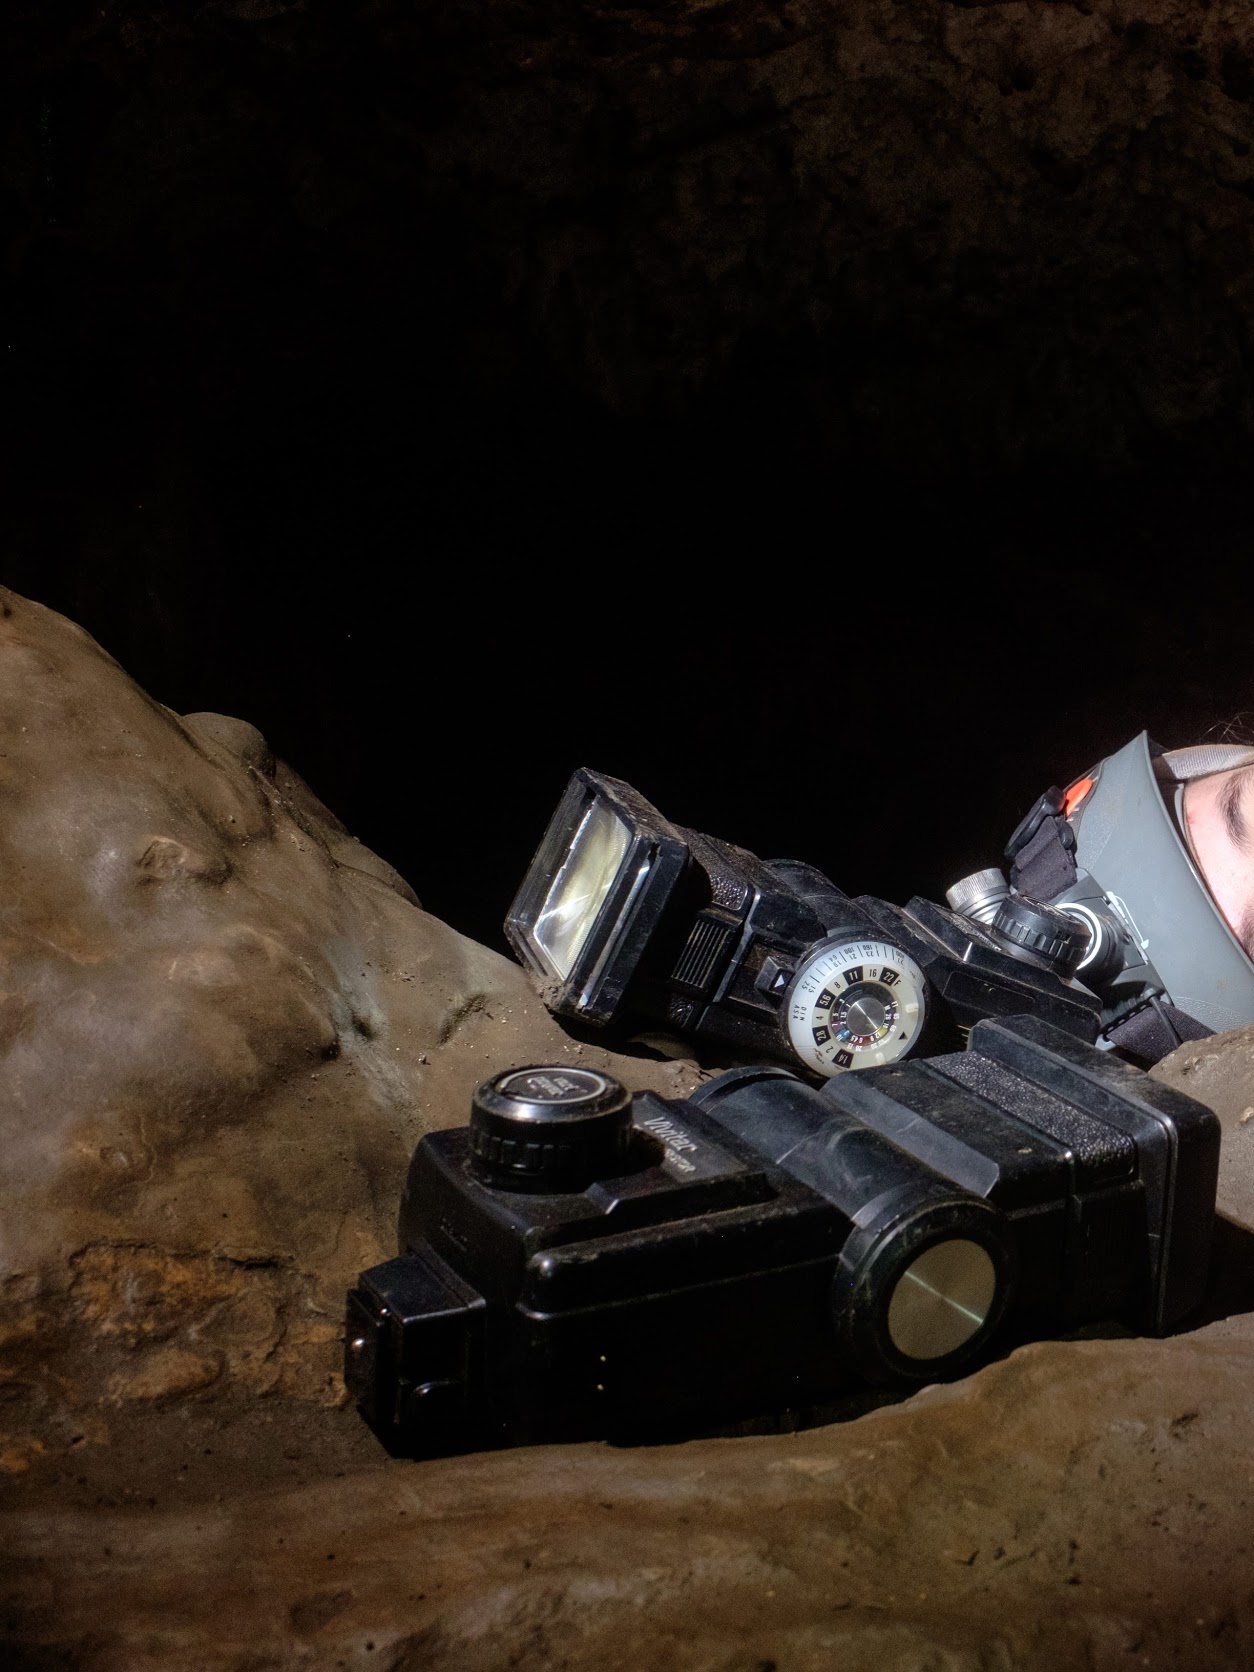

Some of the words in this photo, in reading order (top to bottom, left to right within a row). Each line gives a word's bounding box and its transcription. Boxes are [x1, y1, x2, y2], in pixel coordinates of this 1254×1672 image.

[843, 946, 855, 955] 100
[848, 970, 859, 981] 11
[868, 968, 877, 978] 16
[882, 971, 895, 983] 22
[801, 980, 811, 991] 25
[833, 981, 841, 989] 8
[893, 979, 902, 987] F
[819, 994, 832, 1006] 5.6
[792, 1004, 801, 1019] ASA
[799, 1006, 808, 1021] DIN
[825, 1045, 834, 1054] 2
[643, 1116, 698, 1151] Vivitar
